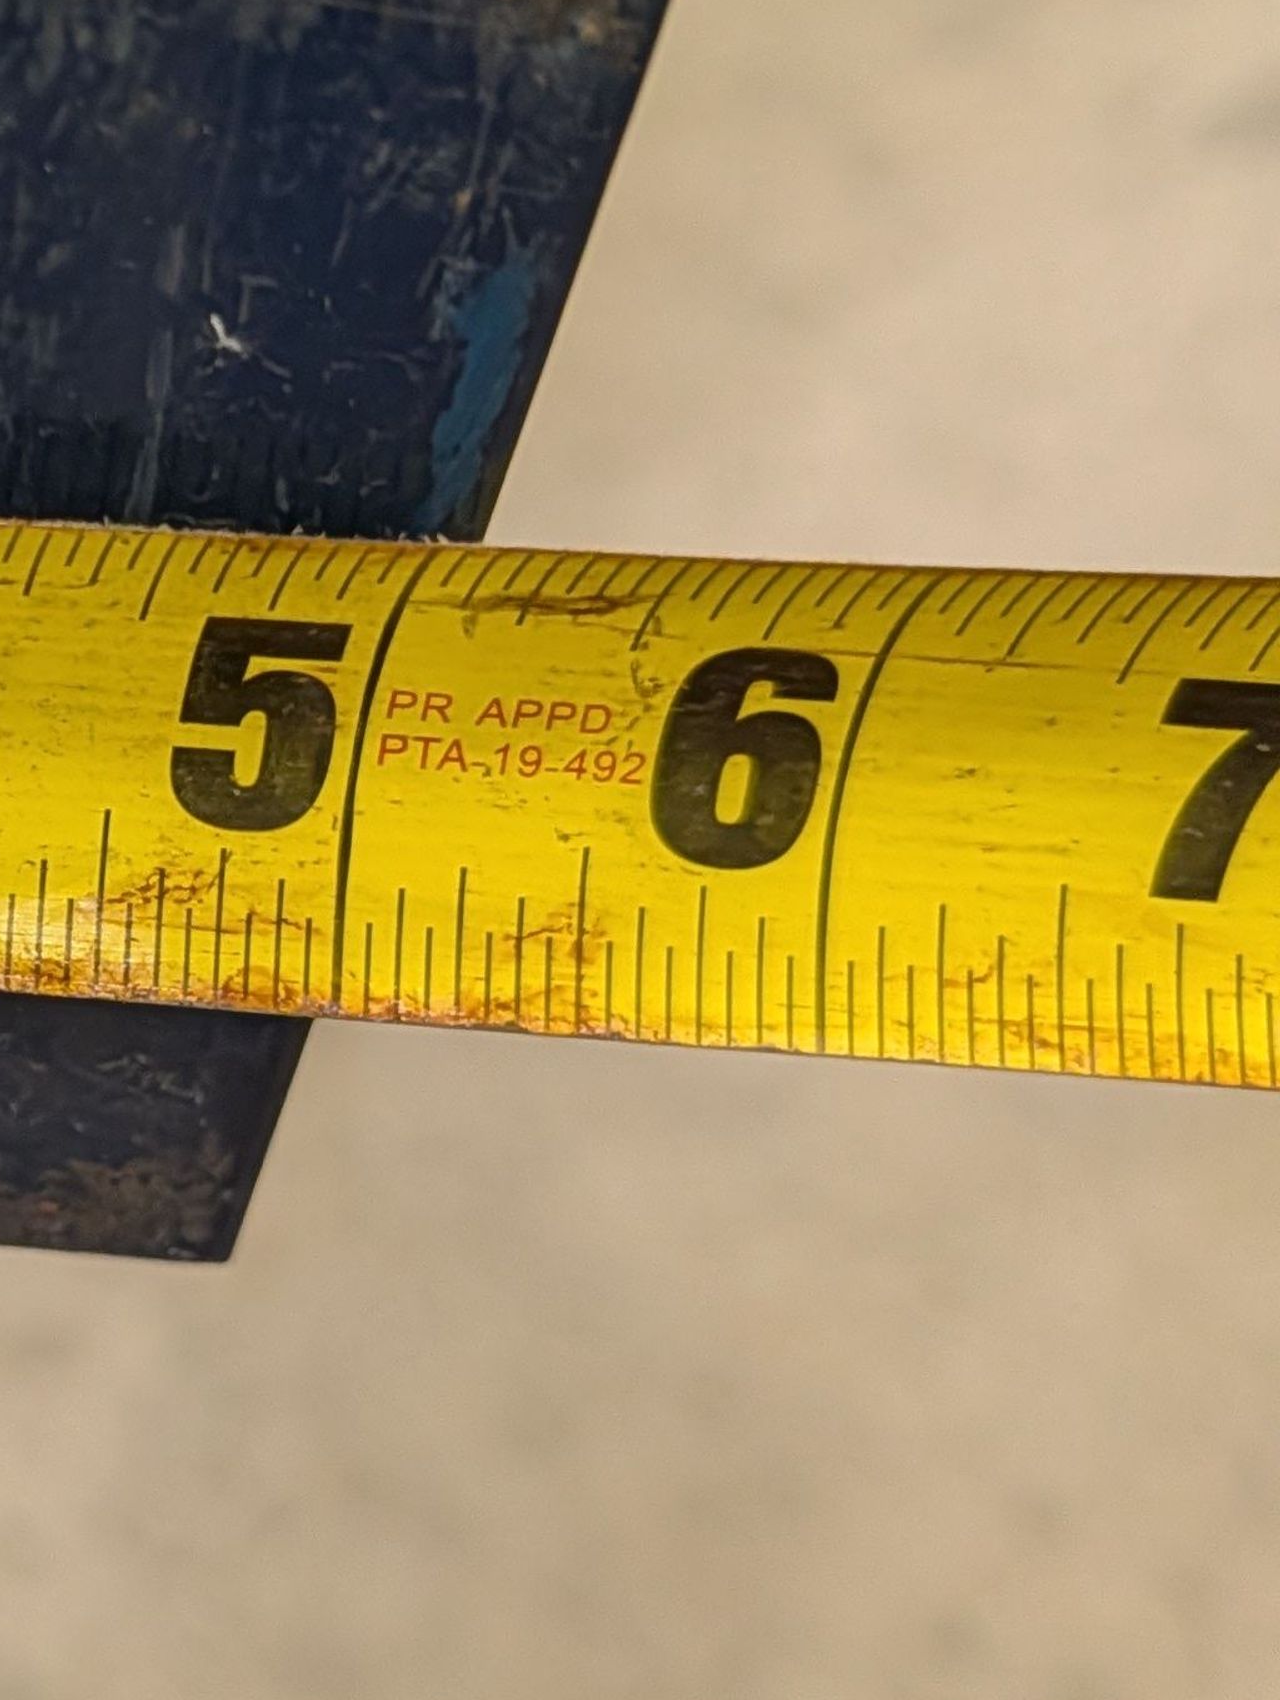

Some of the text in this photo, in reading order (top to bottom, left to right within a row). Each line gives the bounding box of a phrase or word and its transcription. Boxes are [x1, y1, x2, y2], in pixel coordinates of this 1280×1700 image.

[169, 616, 355, 833] 5
[376, 733, 647, 785] PTA-19-492
[385, 689, 614, 734] PR APPD
[649, 647, 839, 870] 6
[1148, 677, 1280, 904] 7
